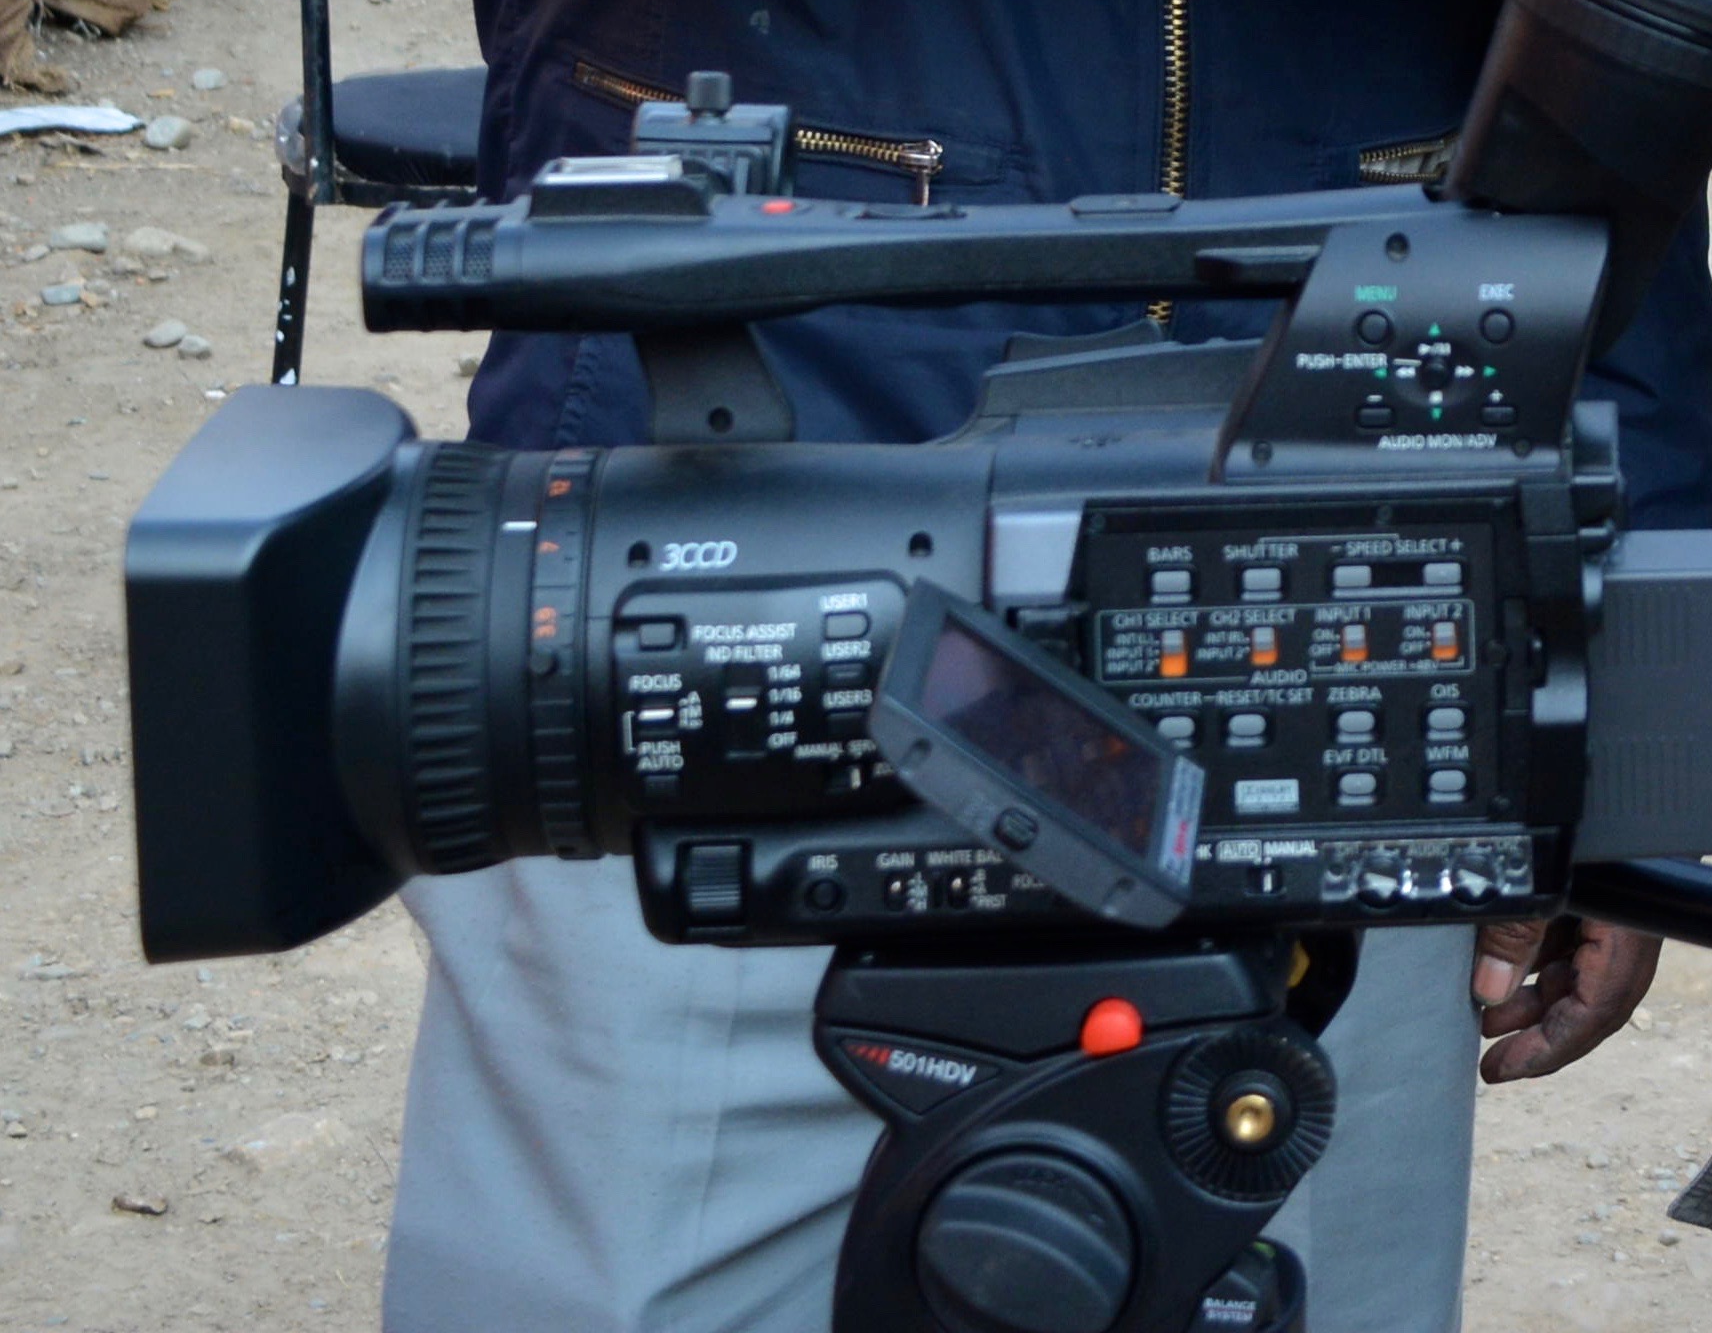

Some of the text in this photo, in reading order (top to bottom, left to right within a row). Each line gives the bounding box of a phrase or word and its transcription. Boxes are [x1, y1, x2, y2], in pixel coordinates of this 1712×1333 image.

[1354, 285, 1398, 302] MENU
[1479, 284, 1515, 301] EXEC
[1379, 435, 1425, 449] AUDIO
[1147, 547, 1193, 562] BARS
[1223, 544, 1299, 560] SHUTTER
[1346, 538, 1446, 556] SPEED SELECT
[660, 540, 738, 572] 3CCD
[819, 594, 869, 611] USER1
[1146, 611, 1198, 627] SELECT
[1210, 609, 1295, 625] CH2 SELECT
[1315, 607, 1371, 621] INPUT 1
[1404, 604, 1462, 619] INPUT 2
[691, 623, 796, 642] FOCUS ASSIST
[705, 645, 783, 663] ND FILTER
[822, 642, 871, 660] USER2
[628, 674, 682, 692] FOCUS
[1251, 670, 1308, 684] AUDIO
[1328, 686, 1382, 701] ZEBRA
[1430, 683, 1460, 698] OIS
[823, 690, 873, 708] USER3
[1129, 692, 1202, 707] COUNTER
[638, 741, 681, 754] PUSH
[768, 732, 798, 748] OFF
[1323, 748, 1388, 765] EVF DTL
[1425, 745, 1469, 760] WFM
[637, 756, 684, 769] AUTO
[1263, 840, 1318, 856] MANUAL
[807, 855, 838, 871] IRIS
[876, 852, 915, 868] GAIN
[926, 849, 972, 865] WHITE
[887, 1050, 977, 1086] 501HDV
[1203, 1297, 1256, 1309] BALANCE
